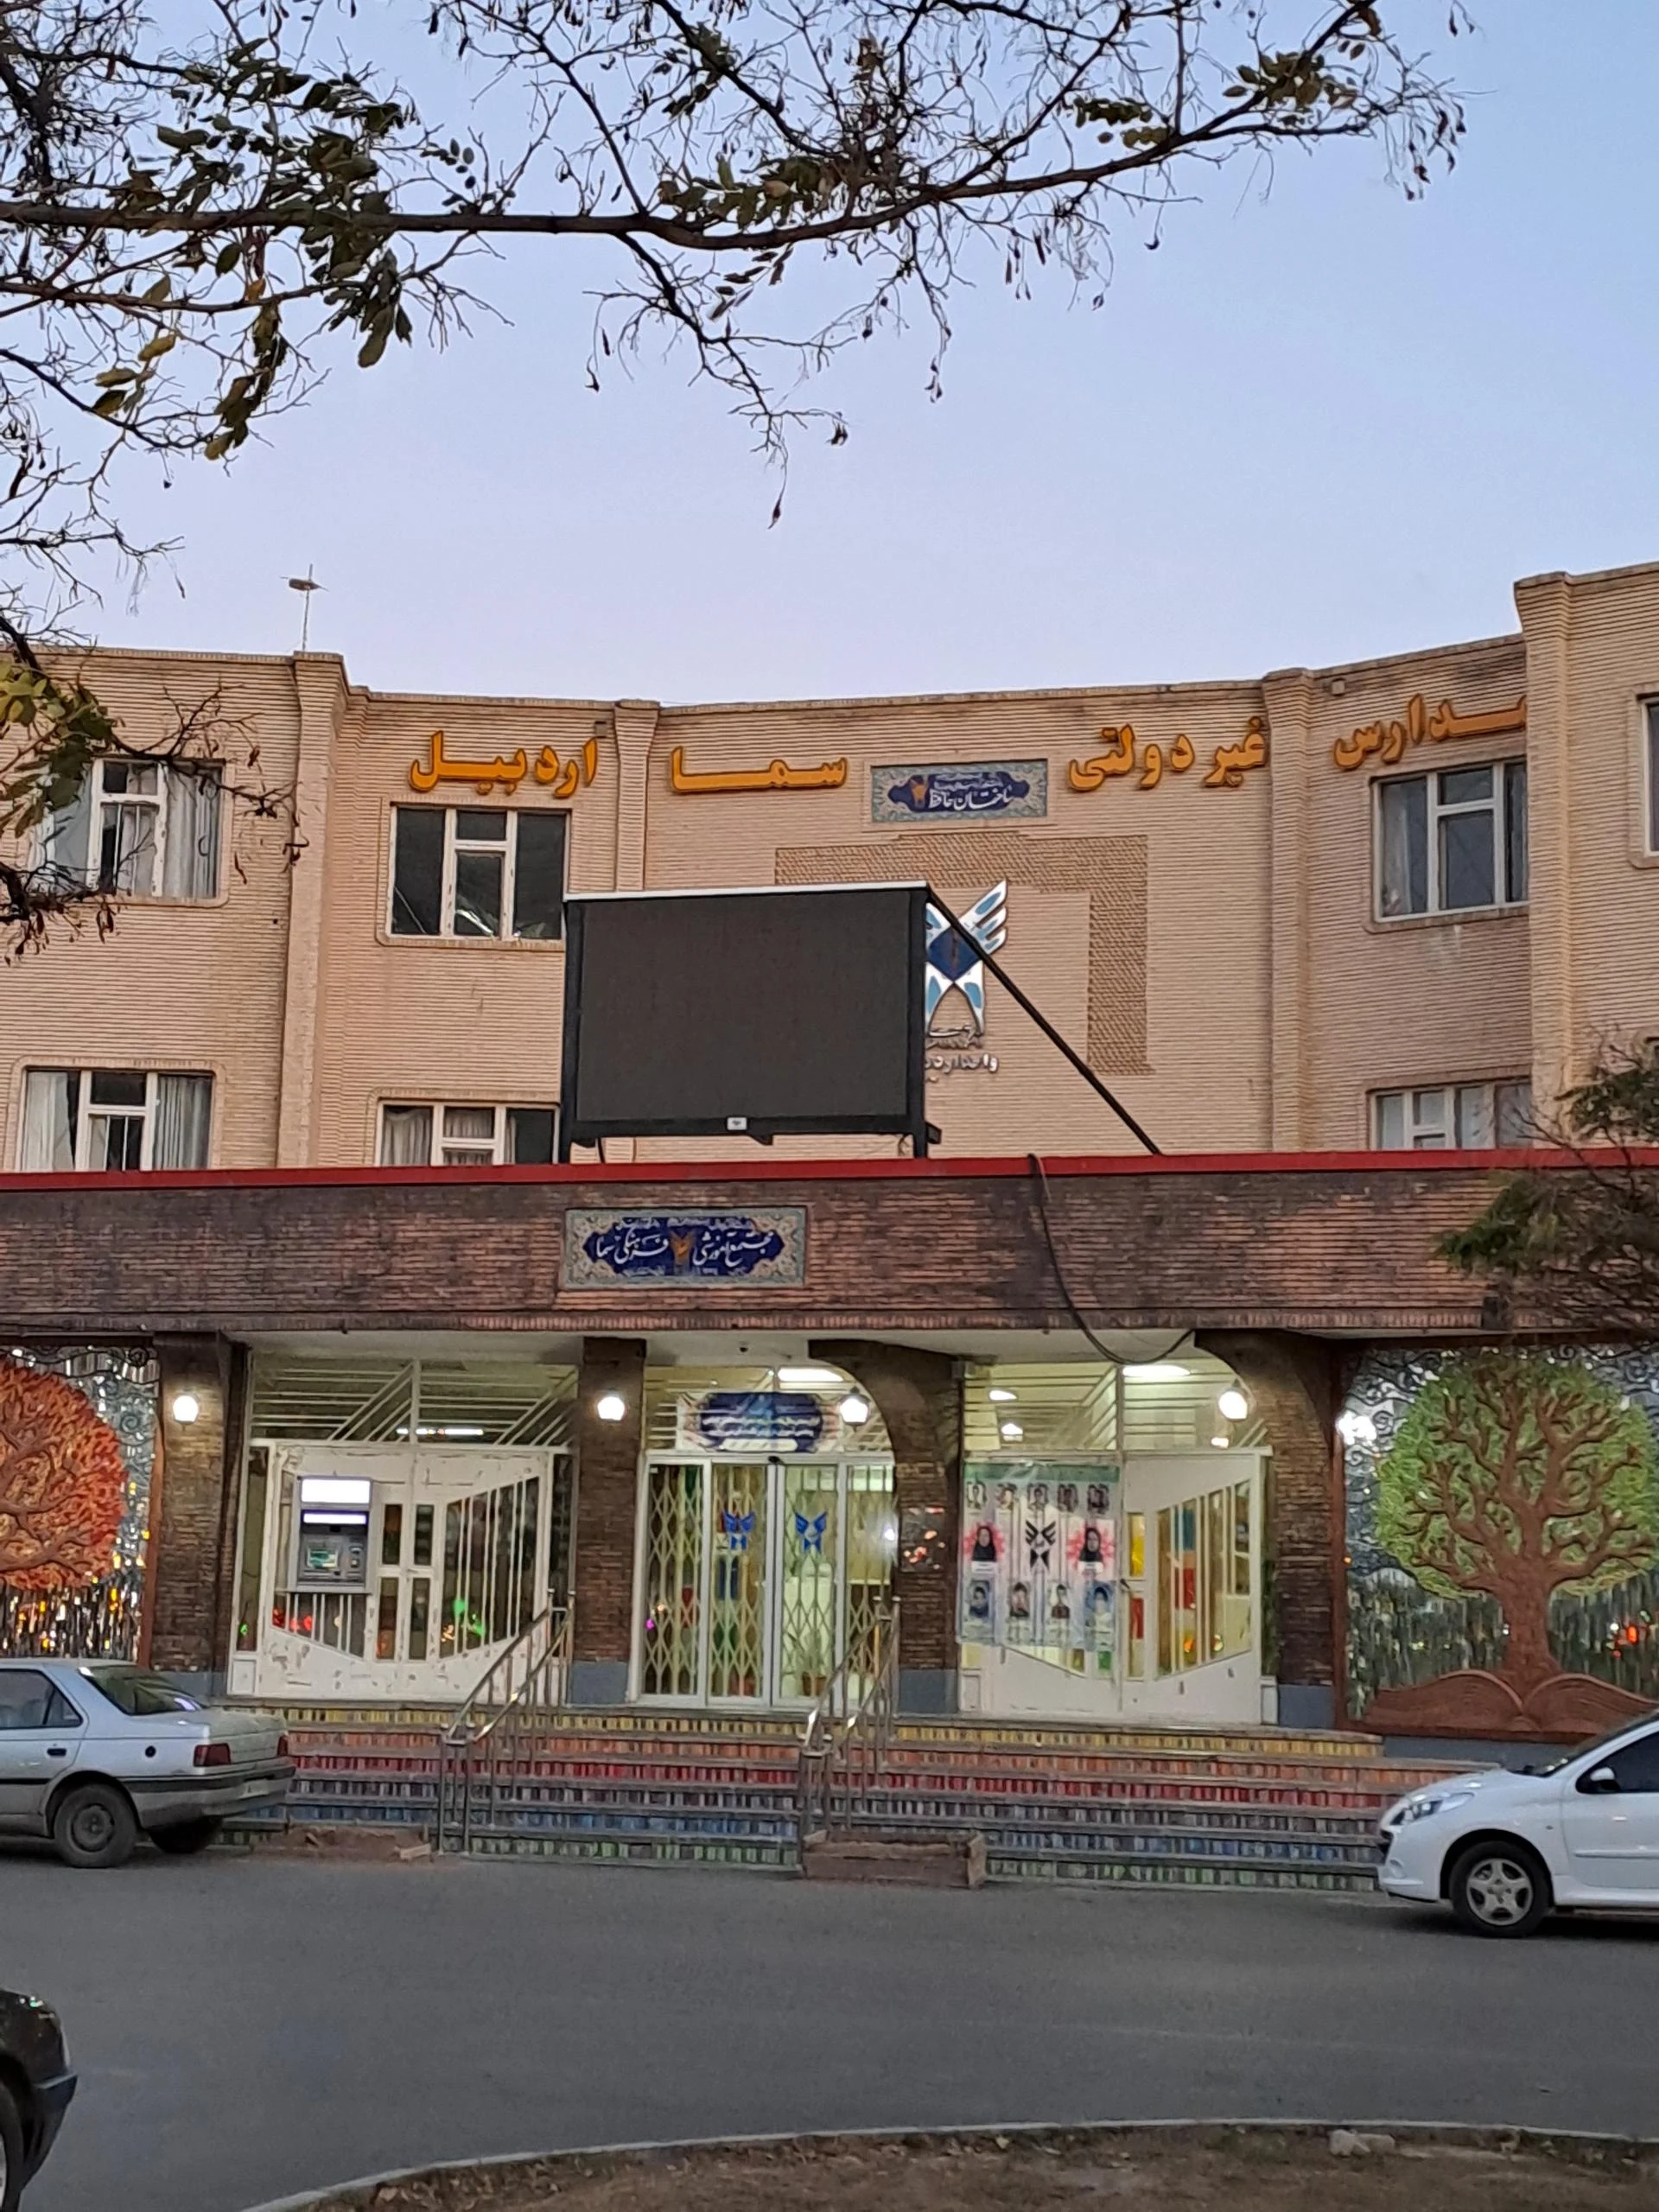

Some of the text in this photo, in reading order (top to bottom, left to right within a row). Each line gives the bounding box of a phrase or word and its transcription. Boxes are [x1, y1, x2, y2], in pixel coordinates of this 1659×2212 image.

[409, 730, 599, 798] اردبیل
[671, 747, 848, 793] سما
[1201, 715, 1268, 788] غیر
